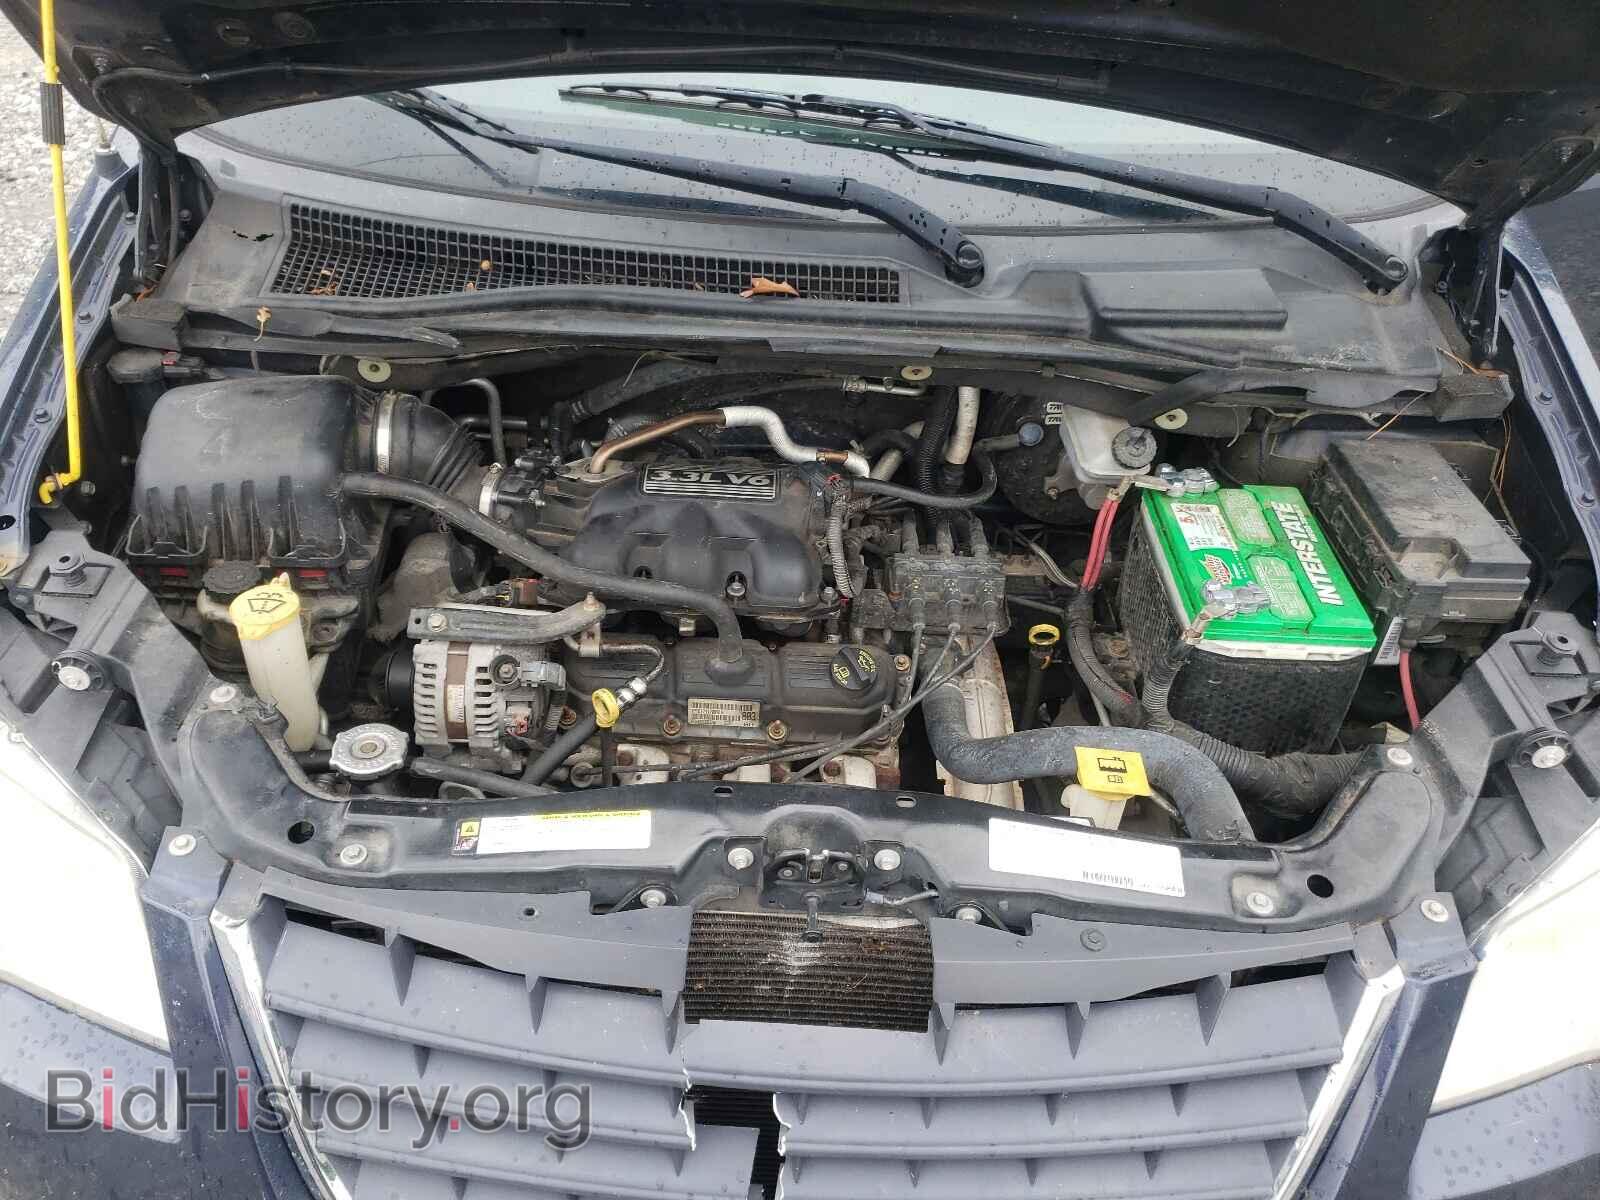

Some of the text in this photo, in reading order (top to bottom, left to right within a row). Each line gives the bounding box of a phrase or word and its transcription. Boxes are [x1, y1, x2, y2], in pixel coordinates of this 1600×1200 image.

[650, 470, 770, 486] 3.3L V6
[1271, 501, 1345, 606] INTERSTATE
